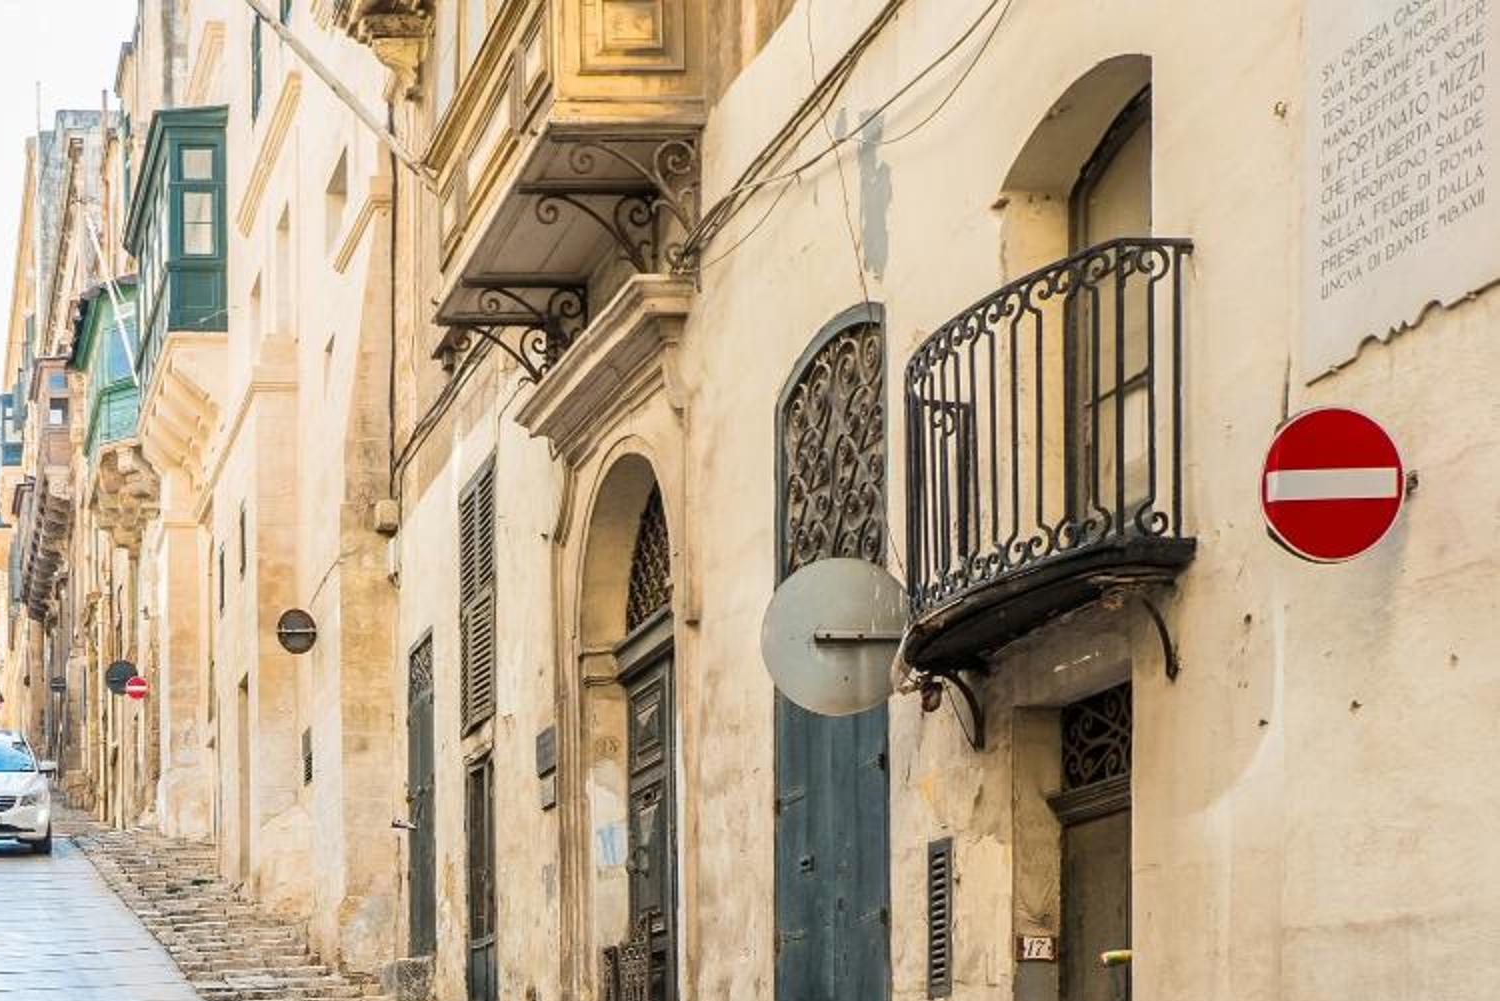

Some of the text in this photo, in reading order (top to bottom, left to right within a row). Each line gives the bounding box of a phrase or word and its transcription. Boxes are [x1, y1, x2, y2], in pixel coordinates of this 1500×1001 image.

[1337, 91, 1429, 171] FORTVNATO
[1438, 50, 1485, 102] MIZZI
[1438, 84, 1484, 128] NAZIO
[1374, 184, 1410, 221] FEDE
[1439, 138, 1483, 178] ROMA
[1386, 222, 1429, 261] DANTE
